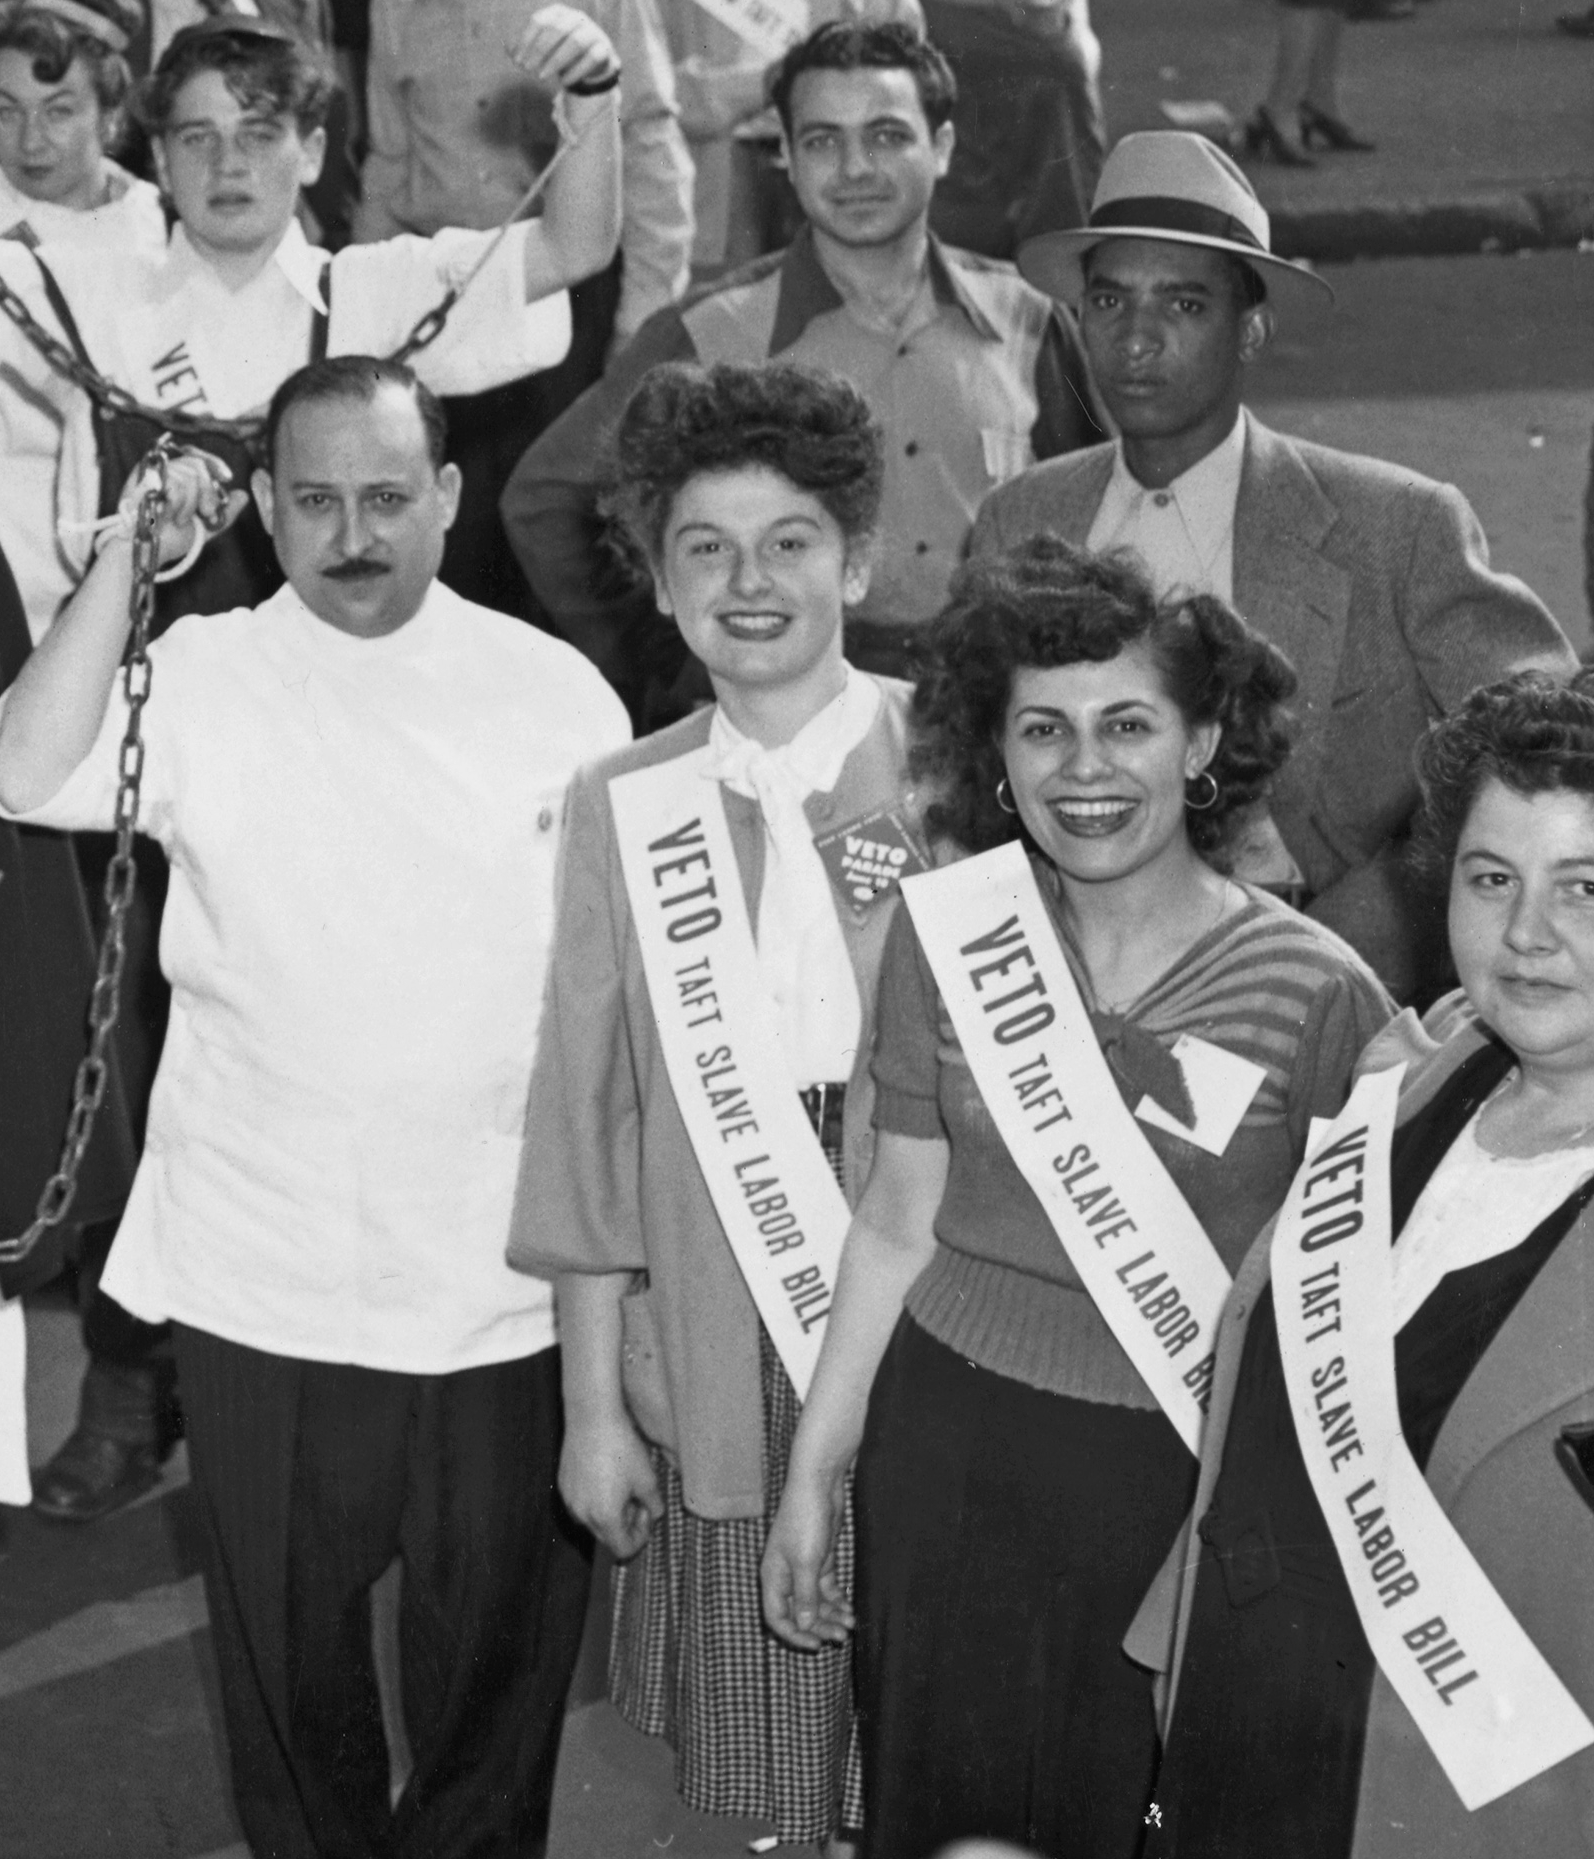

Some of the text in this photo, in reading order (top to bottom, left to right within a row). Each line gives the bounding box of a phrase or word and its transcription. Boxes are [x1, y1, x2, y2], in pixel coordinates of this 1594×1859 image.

[151, 341, 208, 413] VET
[845, 835, 908, 866] VETO
[647, 817, 831, 1335] VETO TAFT SLAVE LABOR BILL
[959, 913, 1057, 1047] VETO
[1008, 1052, 1073, 1134] TAFT
[1052, 1143, 1138, 1250] SLAVE
[1114, 1250, 1201, 1358] LABOR
[1300, 1124, 1481, 1708] VETO TAFT SLAVE LABOR BILL
